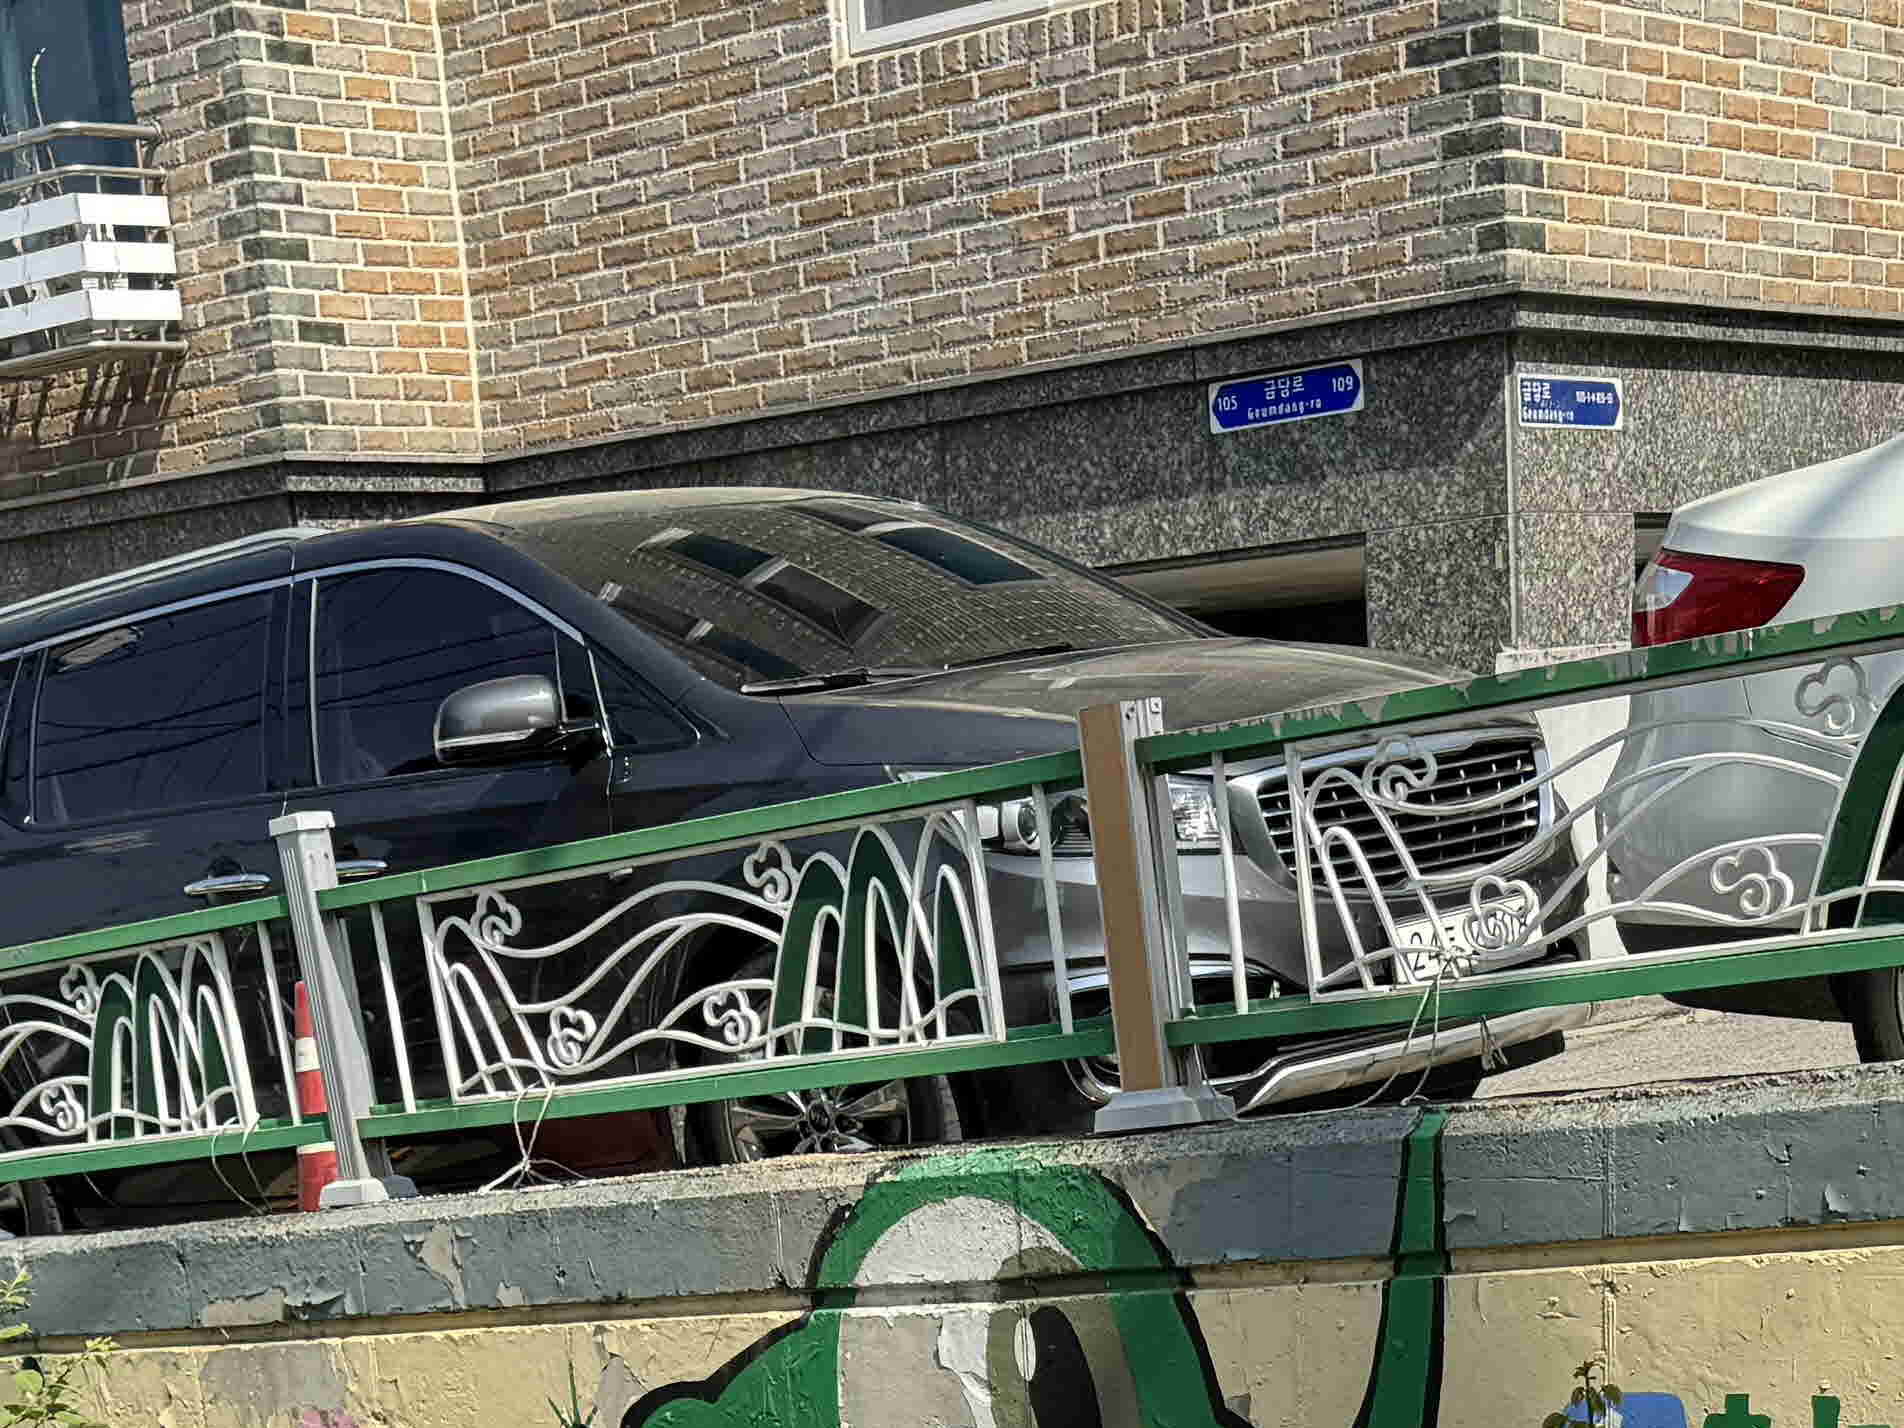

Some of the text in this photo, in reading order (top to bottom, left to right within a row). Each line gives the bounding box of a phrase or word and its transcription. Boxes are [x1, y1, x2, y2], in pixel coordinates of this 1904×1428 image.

[1264, 375, 1304, 400] 금당로
[1332, 376, 1354, 393] 109
[1217, 396, 1238, 412] 105
